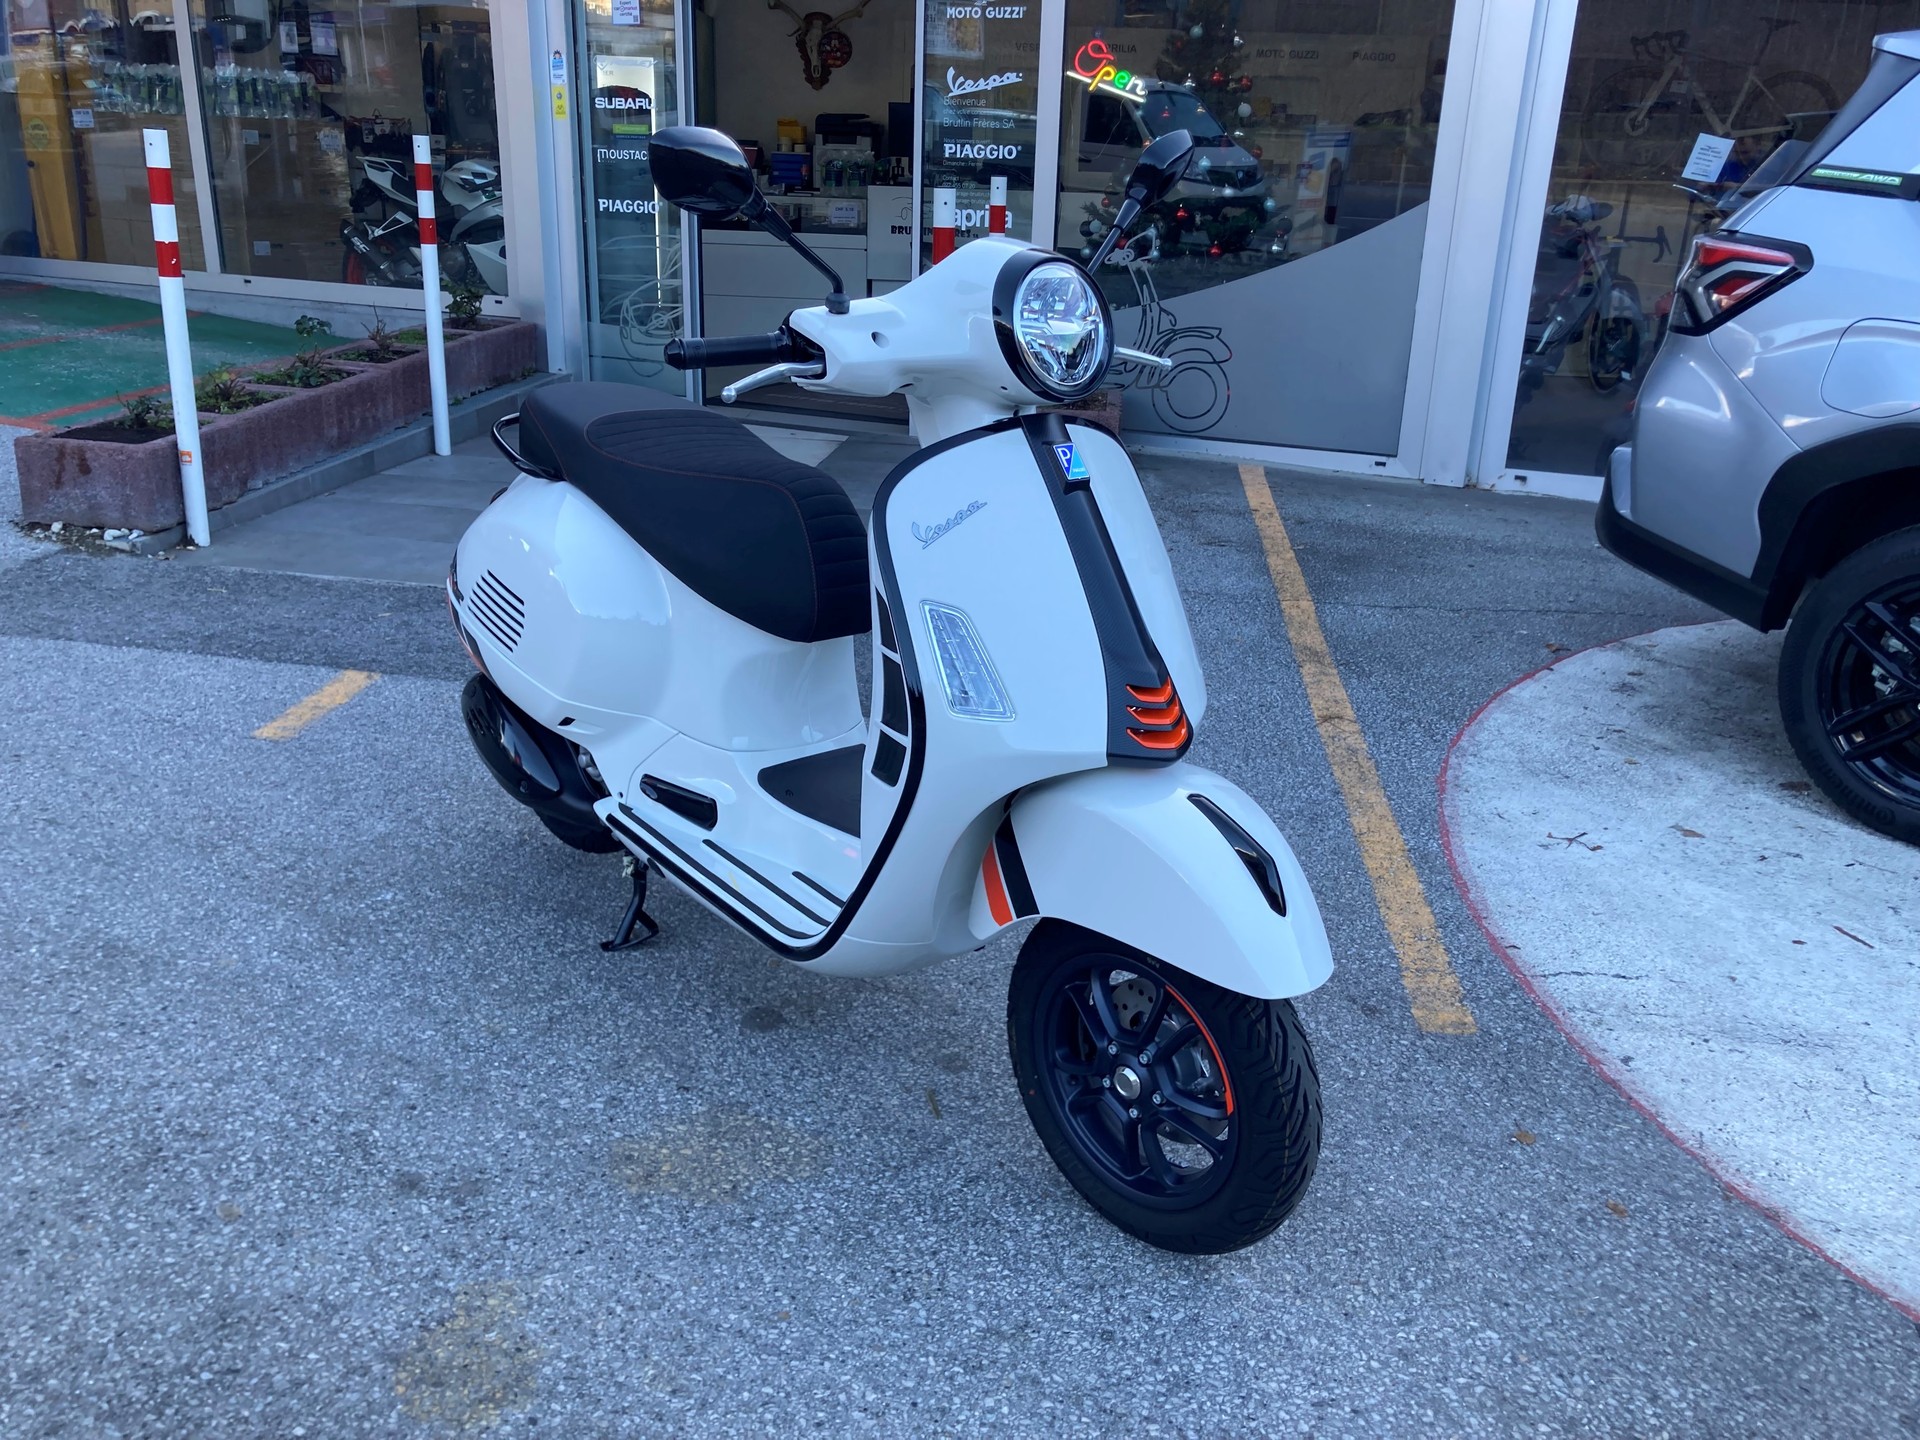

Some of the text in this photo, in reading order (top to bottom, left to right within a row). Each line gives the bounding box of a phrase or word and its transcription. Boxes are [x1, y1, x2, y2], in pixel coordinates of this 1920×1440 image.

[946, 7, 981, 19] MOTO
[1288, 50, 1319, 60] GUZZI
[1352, 51, 1396, 62] PIAGGIO
[1074, 39, 1149, 93] Open
[946, 66, 1023, 97] Vespa
[594, 97, 656, 110] SUBARU
[943, 96, 986, 107] Bienvenue
[973, 118, 1000, 129] Frères
[1001, 119, 1016, 129] SA
[597, 148, 648, 162] MOUSTAC
[943, 144, 1017, 160] PIAGGIO
[598, 198, 660, 214] PIAGGIO
[911, 500, 988, 550] Vespa
